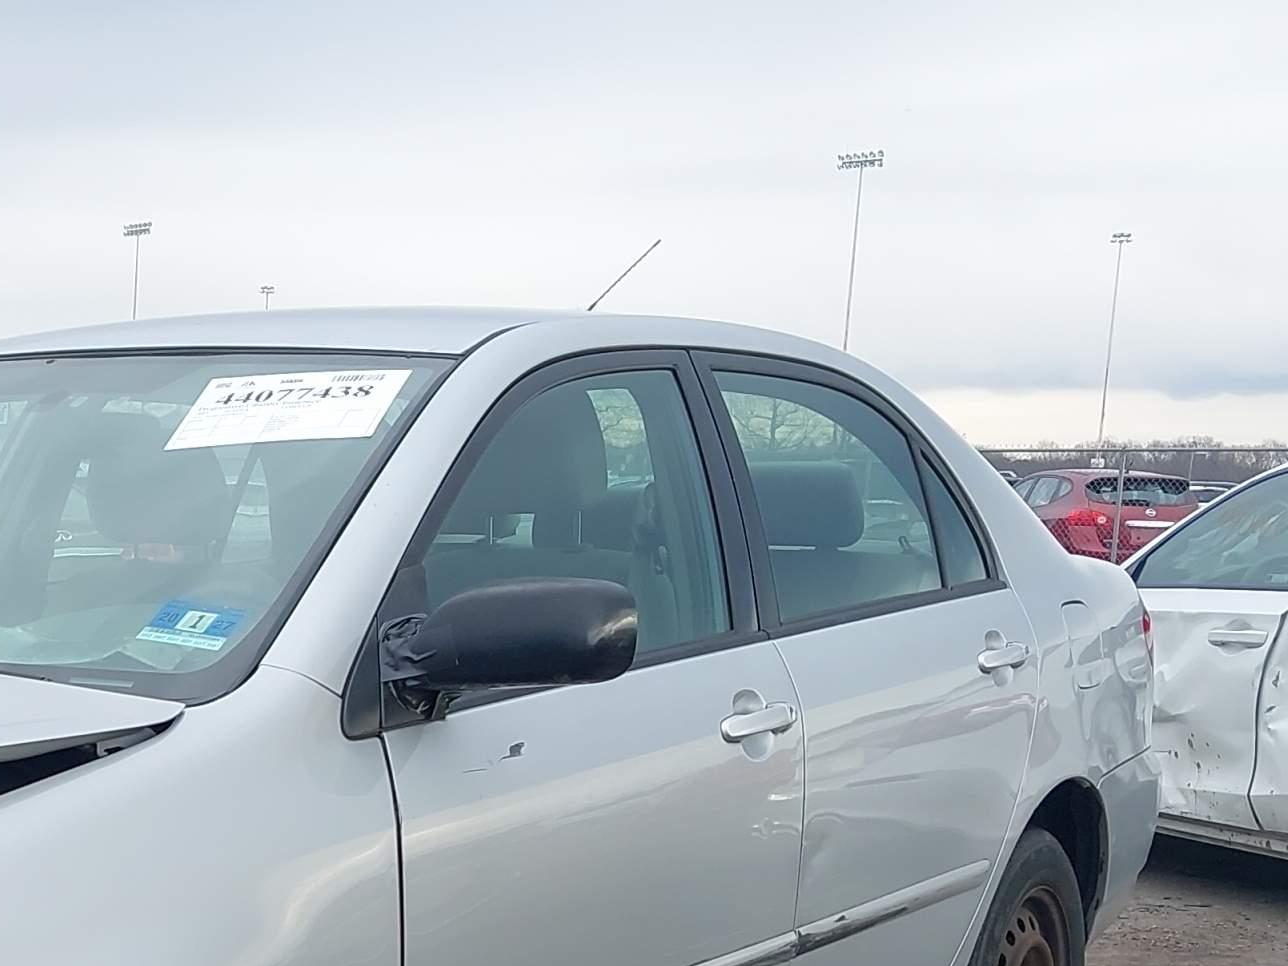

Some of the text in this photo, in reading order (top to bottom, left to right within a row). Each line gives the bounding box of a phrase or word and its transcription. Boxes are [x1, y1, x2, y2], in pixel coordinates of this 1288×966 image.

[216, 384, 375, 406] 44077438
[158, 611, 237, 631] 20 1 27
